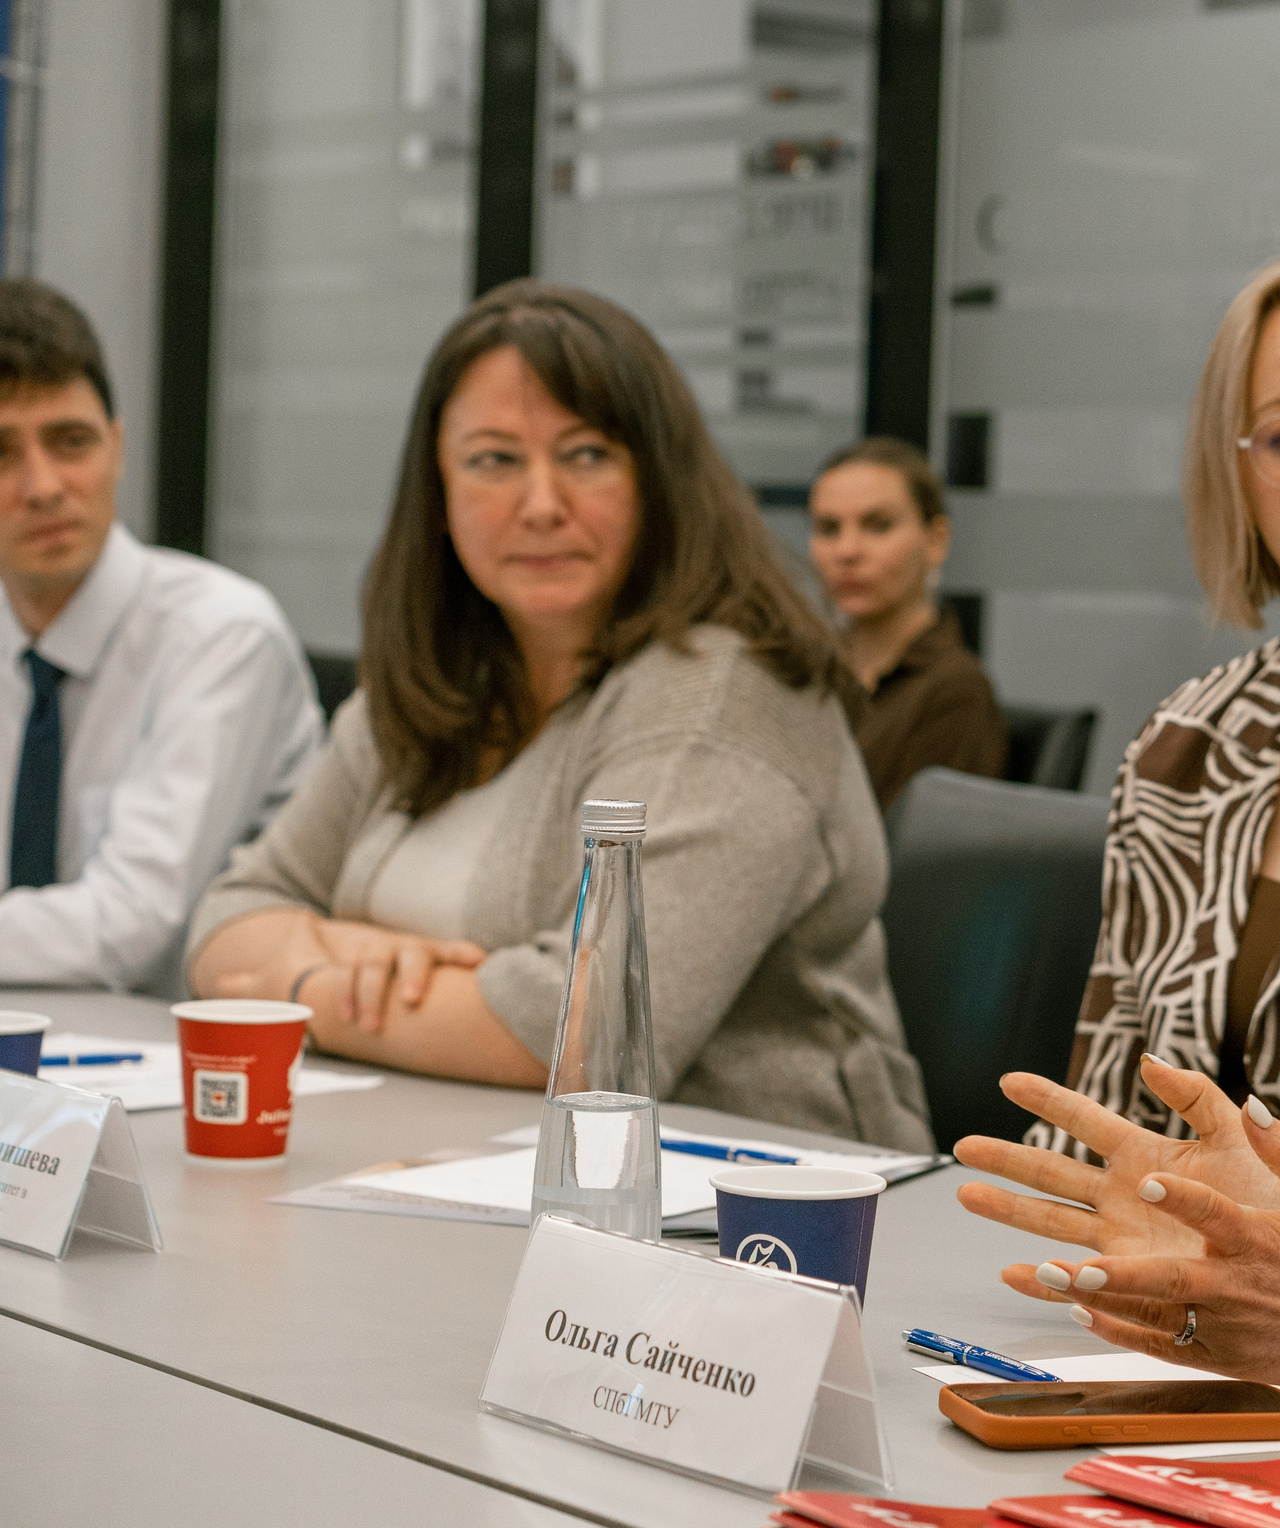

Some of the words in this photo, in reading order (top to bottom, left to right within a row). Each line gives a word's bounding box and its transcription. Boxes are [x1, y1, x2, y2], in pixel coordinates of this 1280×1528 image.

[545, 1309, 619, 1358] Ольга
[625, 1332, 756, 1398] Сайченко
[593, 1385, 681, 1430] СПбГМТУ
